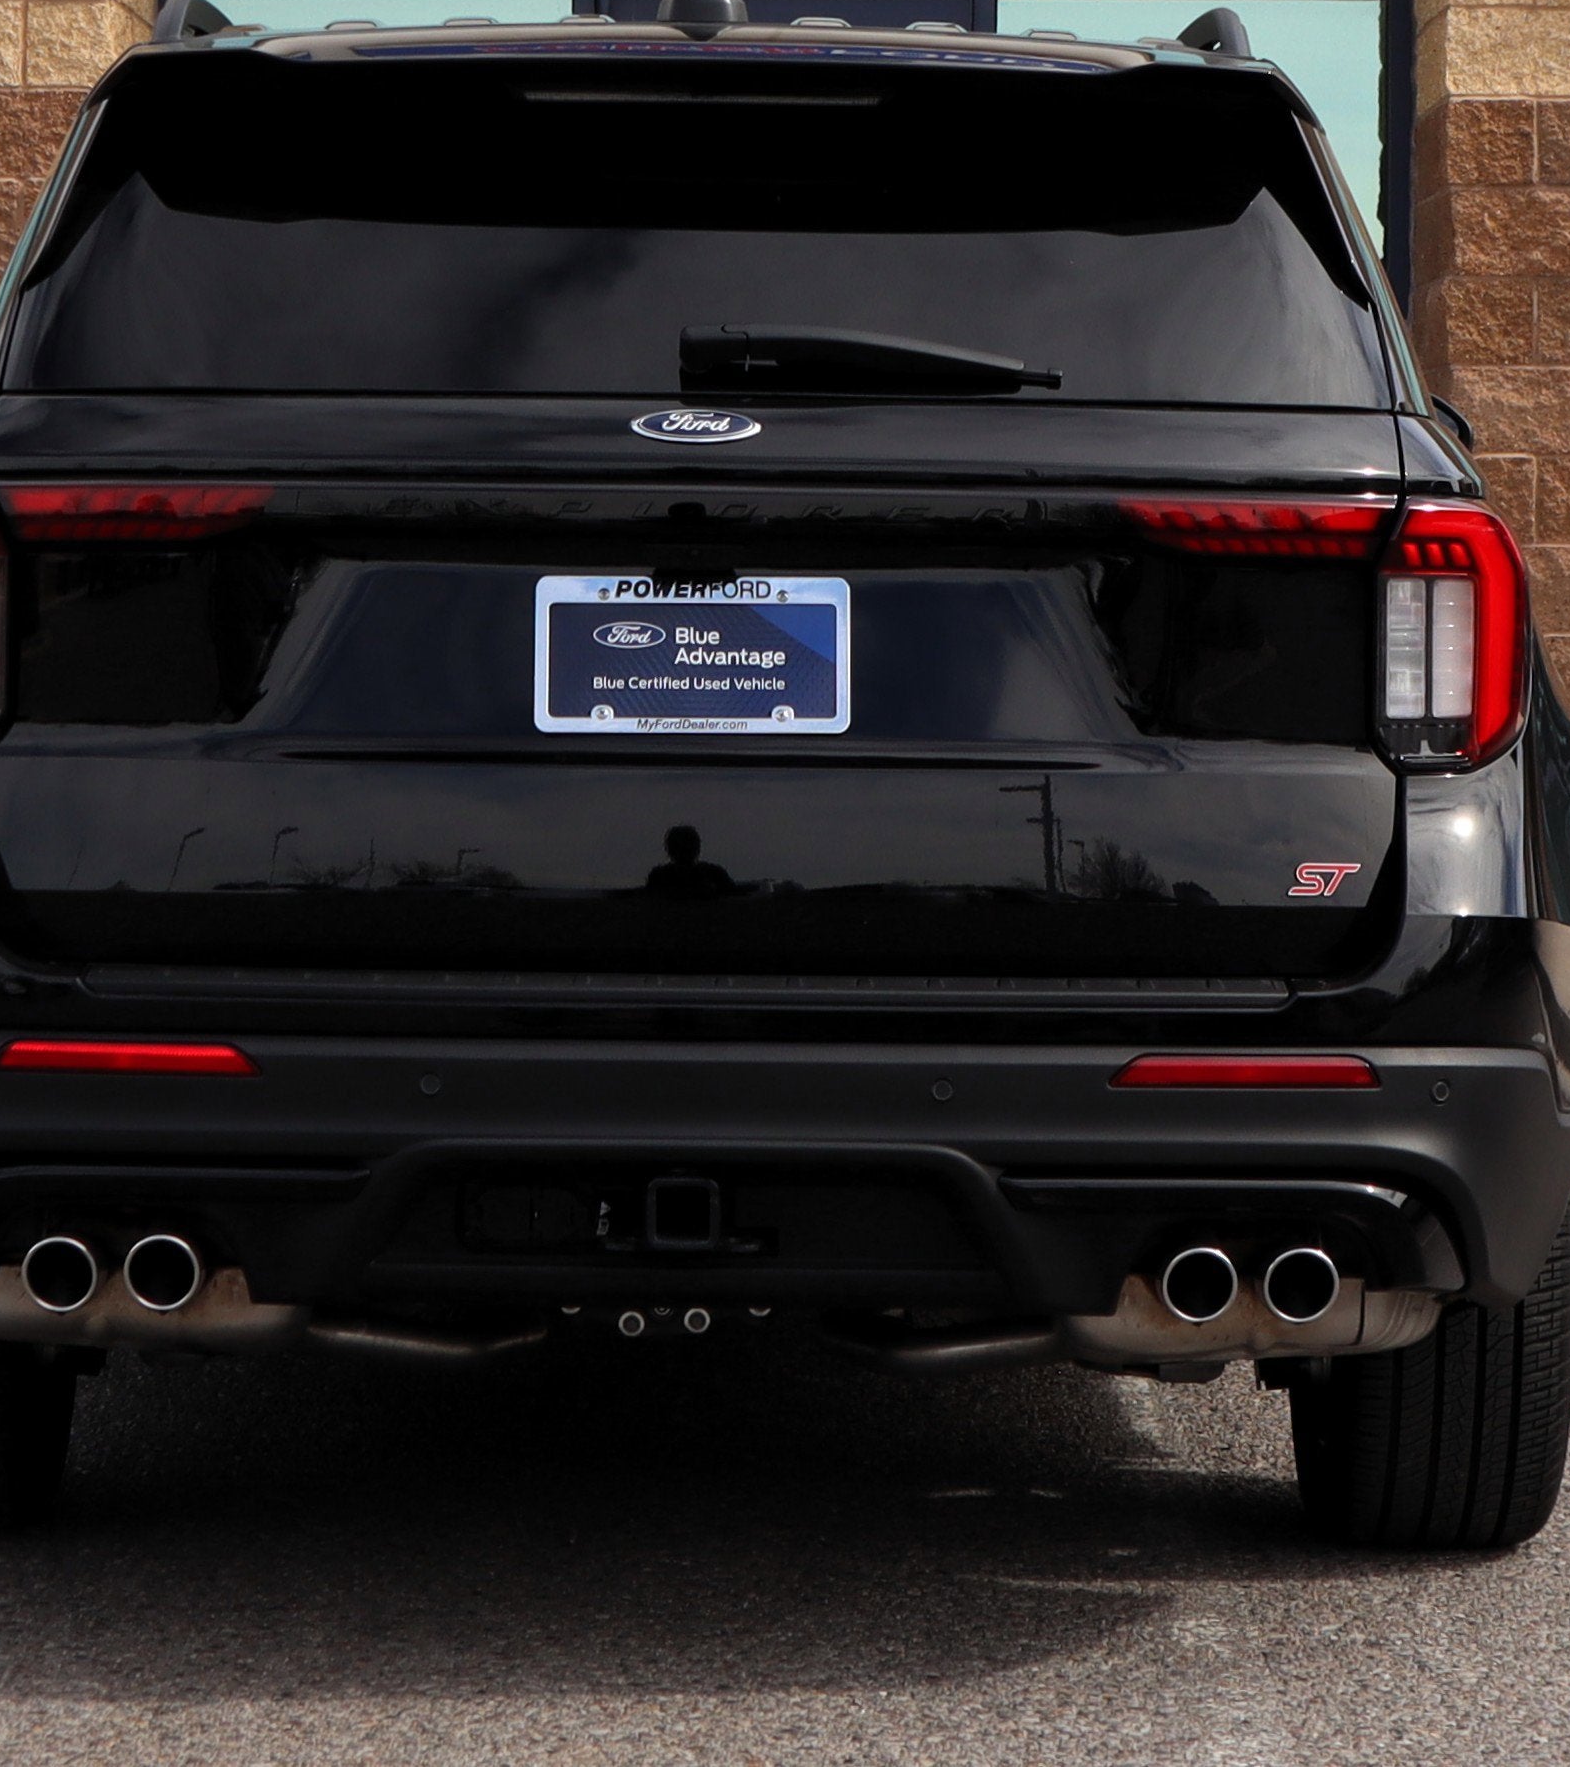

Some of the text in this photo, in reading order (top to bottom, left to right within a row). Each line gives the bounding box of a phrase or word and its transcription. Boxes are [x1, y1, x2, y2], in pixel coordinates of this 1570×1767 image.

[661, 411, 731, 432] Ford
[615, 580, 771, 599] POWERFORD
[606, 624, 651, 645] Ford
[675, 627, 720, 645] Blue
[674, 647, 786, 669] Advantage
[593, 676, 786, 691] Blue Certified Used Vehicle
[636, 718, 748, 732] MyFordDealer.com
[1287, 862, 1362, 896] ST
